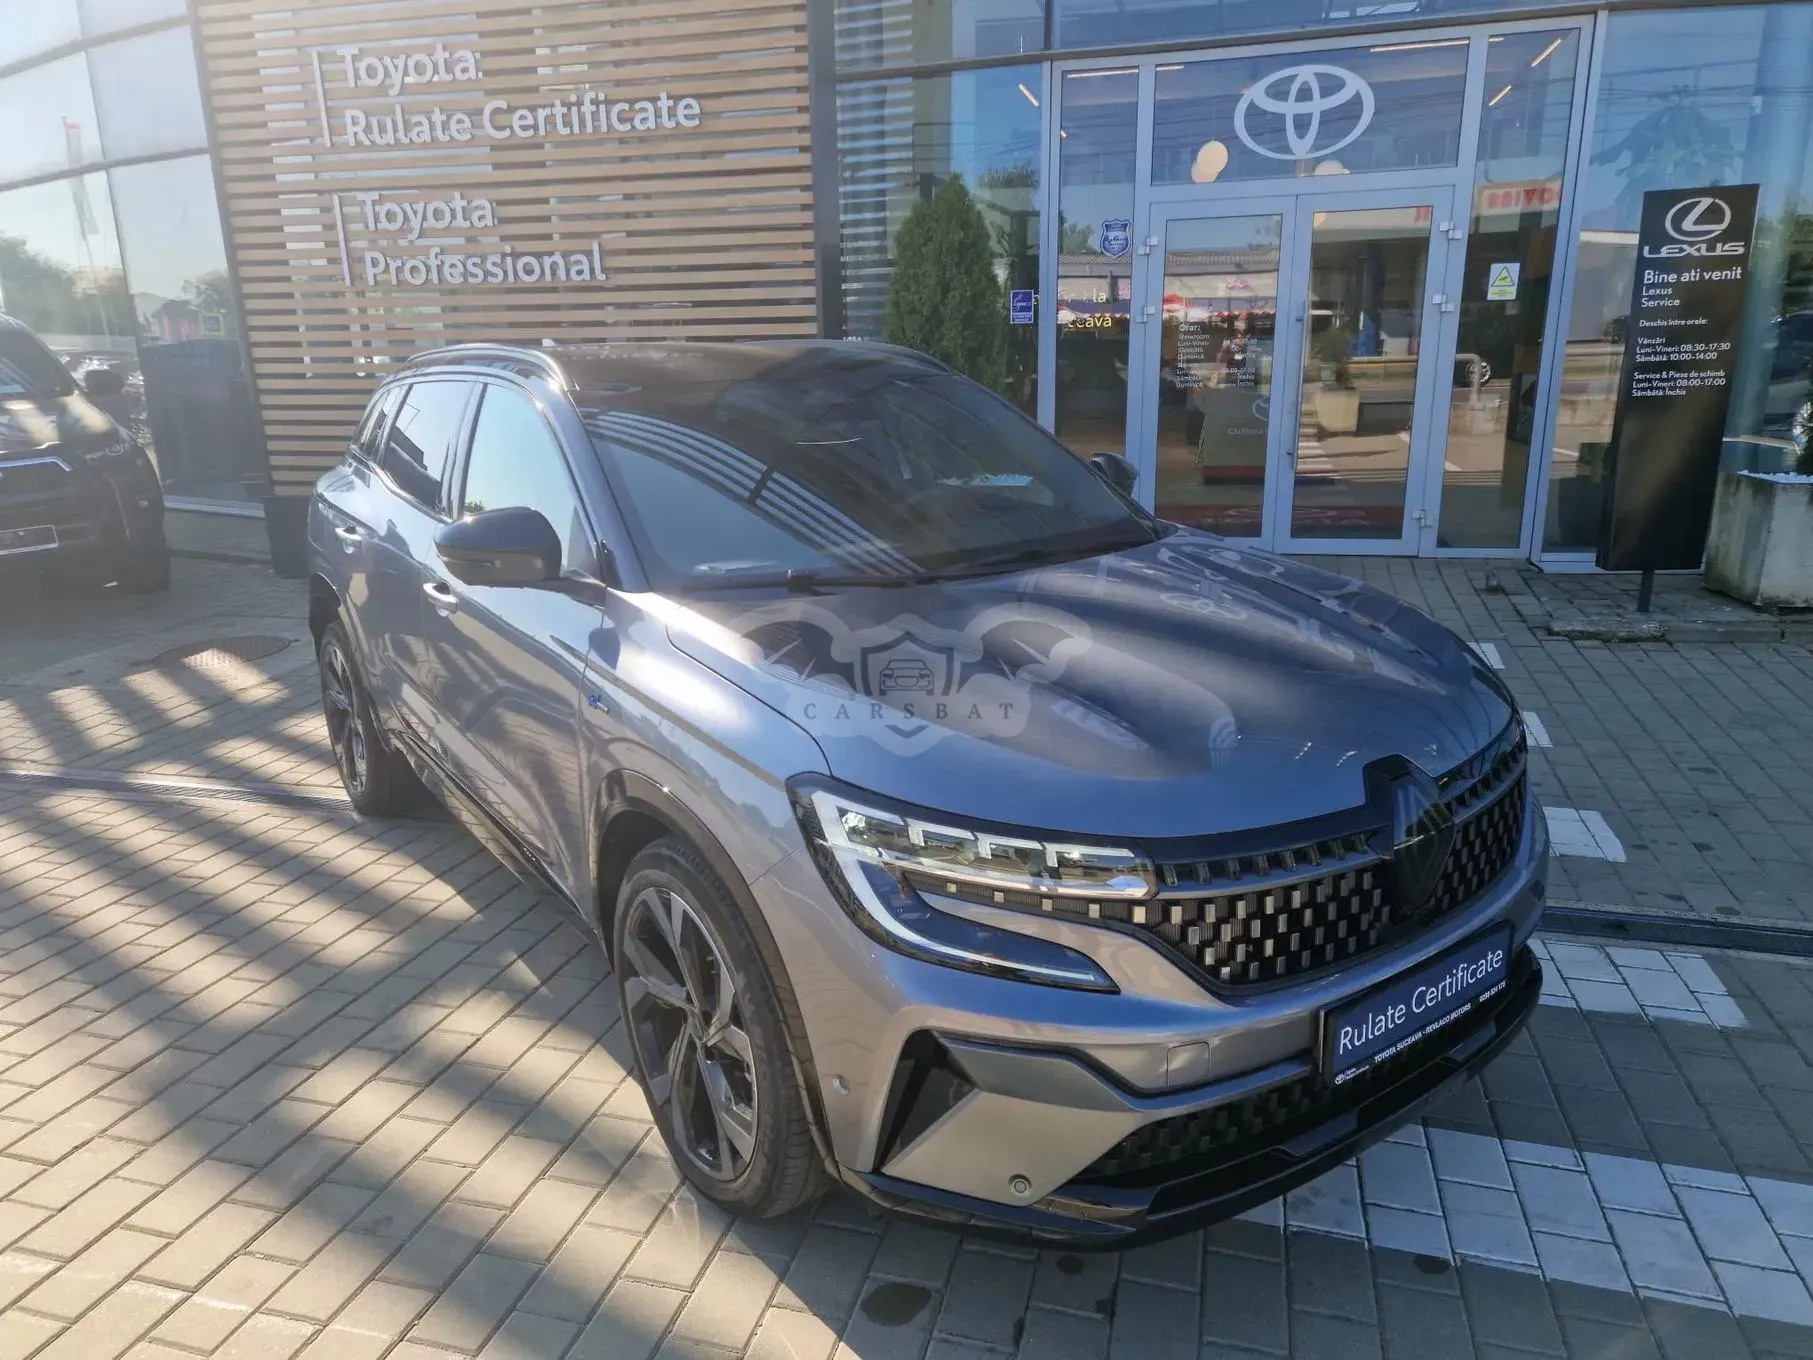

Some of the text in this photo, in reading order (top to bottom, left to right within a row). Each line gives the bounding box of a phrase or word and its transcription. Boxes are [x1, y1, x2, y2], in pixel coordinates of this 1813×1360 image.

[336, 43, 479, 95] Toyota
[344, 91, 701, 147] Rulate Certificate
[358, 192, 496, 240] Toyota
[1642, 242, 1745, 258] LEXUS
[364, 241, 606, 286] Professional
[1643, 266, 1742, 284] Bine ati venit
[1642, 286, 1673, 296] Lexus
[1641, 297, 1680, 308] Service
[1680, 342, 1731, 352] 08:30-17:30
[1669, 351, 1718, 361] 10:00-14:00
[1633, 371, 1661, 380] Service
[1661, 371, 1668, 379] &
[1689, 370, 1699, 378] de
[1699, 369, 1726, 378] schimb
[1676, 378, 1727, 387] 08:00-17:00
[1339, 949, 1504, 1055] Rulate Certificate
[1374, 1046, 1397, 1064] TOYOTA
